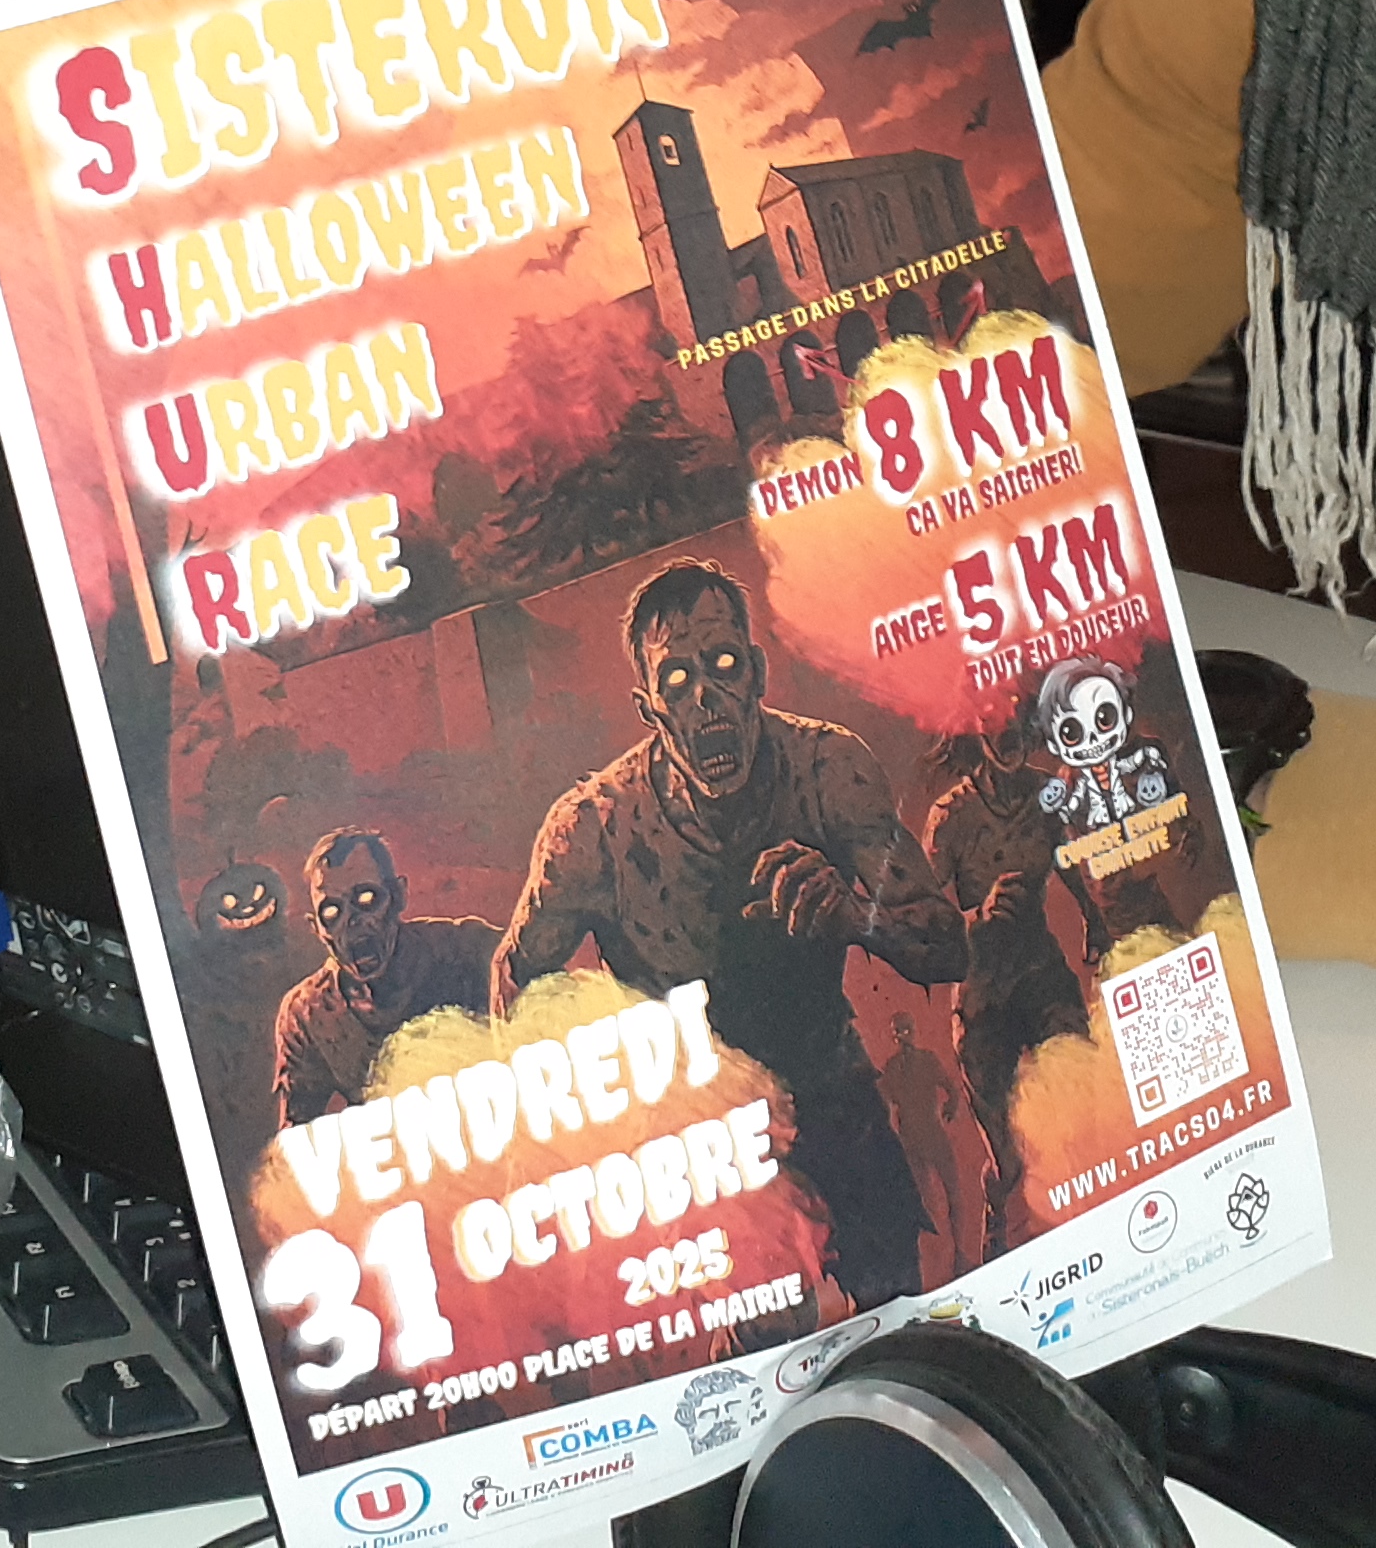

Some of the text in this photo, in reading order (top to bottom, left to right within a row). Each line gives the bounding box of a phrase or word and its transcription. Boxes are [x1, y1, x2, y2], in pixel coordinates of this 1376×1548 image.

[106, 126, 590, 352] HALLOWEEN
[677, 230, 1008, 370] PASSAGE DANS LA CITADELLE
[142, 322, 444, 493] URBAN
[758, 335, 1072, 517] DEMON 8 KM
[905, 445, 1085, 537] CA VA SAIGNER!
[181, 492, 410, 652] RACE
[874, 503, 1132, 660] ANGE 5 KM
[966, 595, 1150, 691] TOUT EN DOUCEUR
[276, 978, 721, 1218] VENDREDI
[1048, 1077, 1275, 1213] WWW.TRACS04.FR
[260, 1098, 780, 1393] 31 OCTOBRE
[617, 1227, 735, 1307] 2025
[1034, 1251, 1104, 1302] JIGRID
[308, 1272, 805, 1442] DÉPART 20H00 PLACE DE LA MAIRIE
[355, 1482, 407, 1521] U
[494, 1457, 636, 1508] ULTRATIMING
[539, 1412, 658, 1461] COMBA
